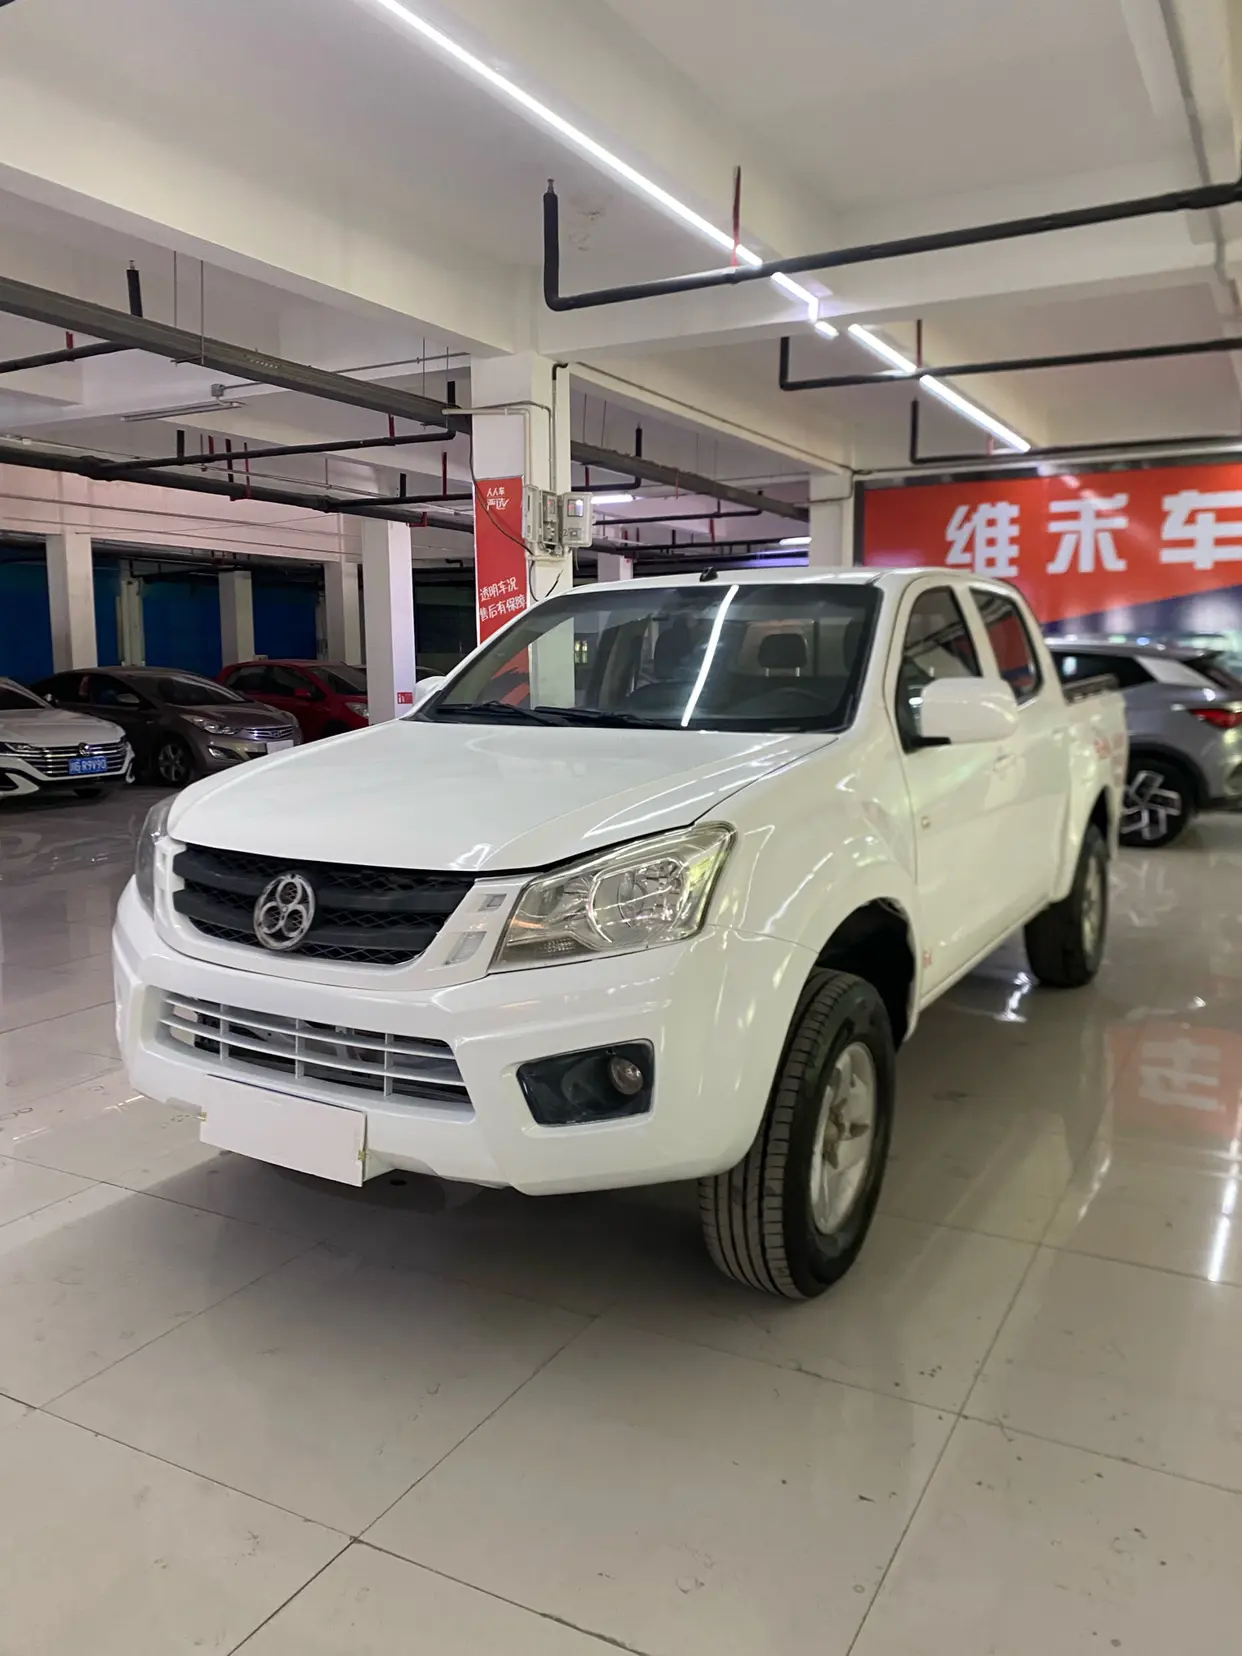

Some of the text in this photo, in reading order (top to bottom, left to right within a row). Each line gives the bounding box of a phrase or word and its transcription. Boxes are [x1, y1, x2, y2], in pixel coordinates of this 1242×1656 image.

[486, 486, 505, 497] 人人车
[479, 576, 519, 602] 透明车况
[479, 594, 526, 622] 售后有保障
